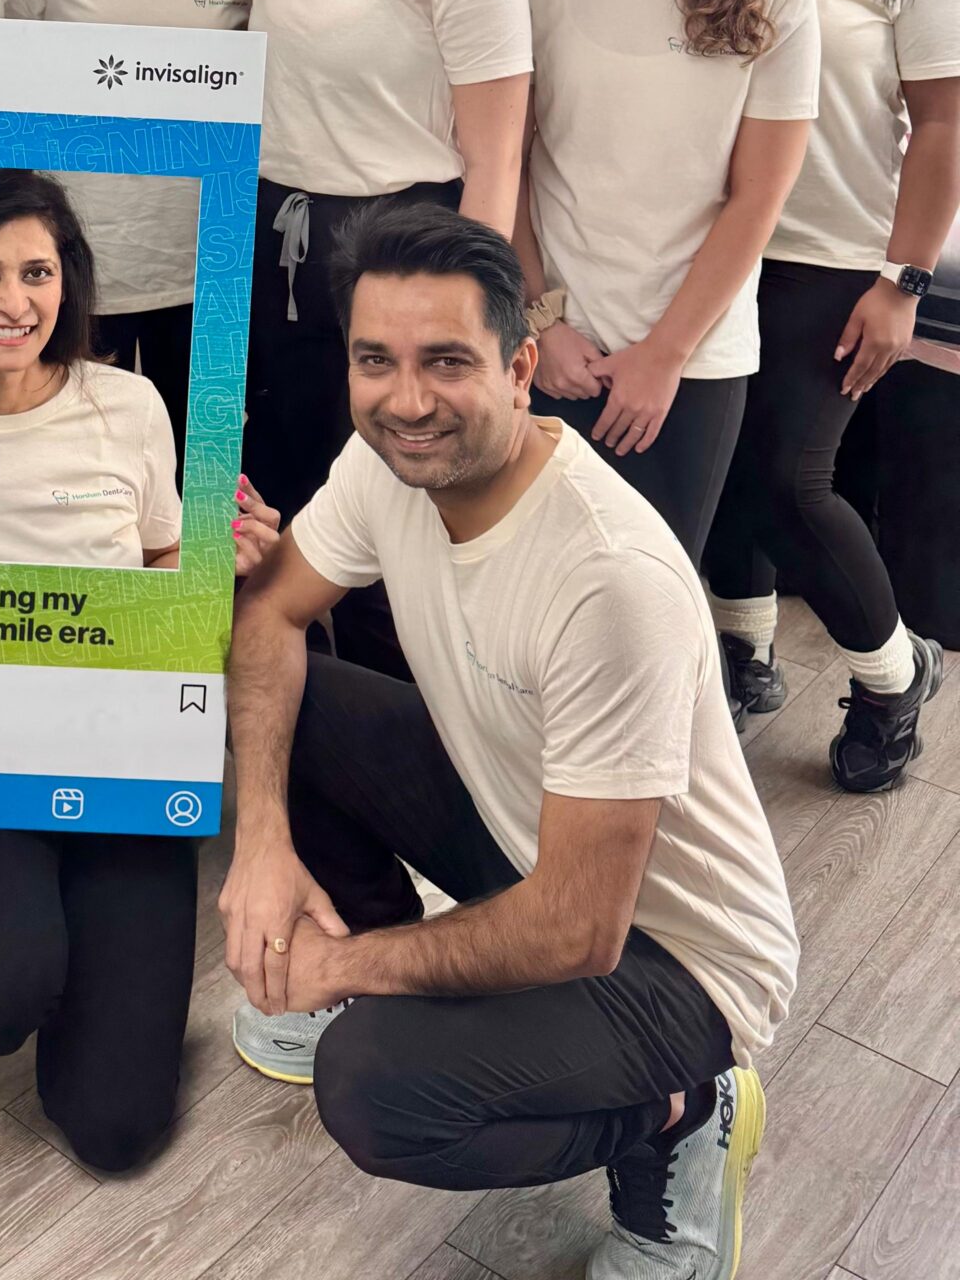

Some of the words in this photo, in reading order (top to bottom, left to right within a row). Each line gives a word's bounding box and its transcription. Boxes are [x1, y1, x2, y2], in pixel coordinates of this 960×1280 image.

[135, 61, 239, 91] invisalign
[42, 592, 88, 617] my
[58, 625, 115, 646] era.
